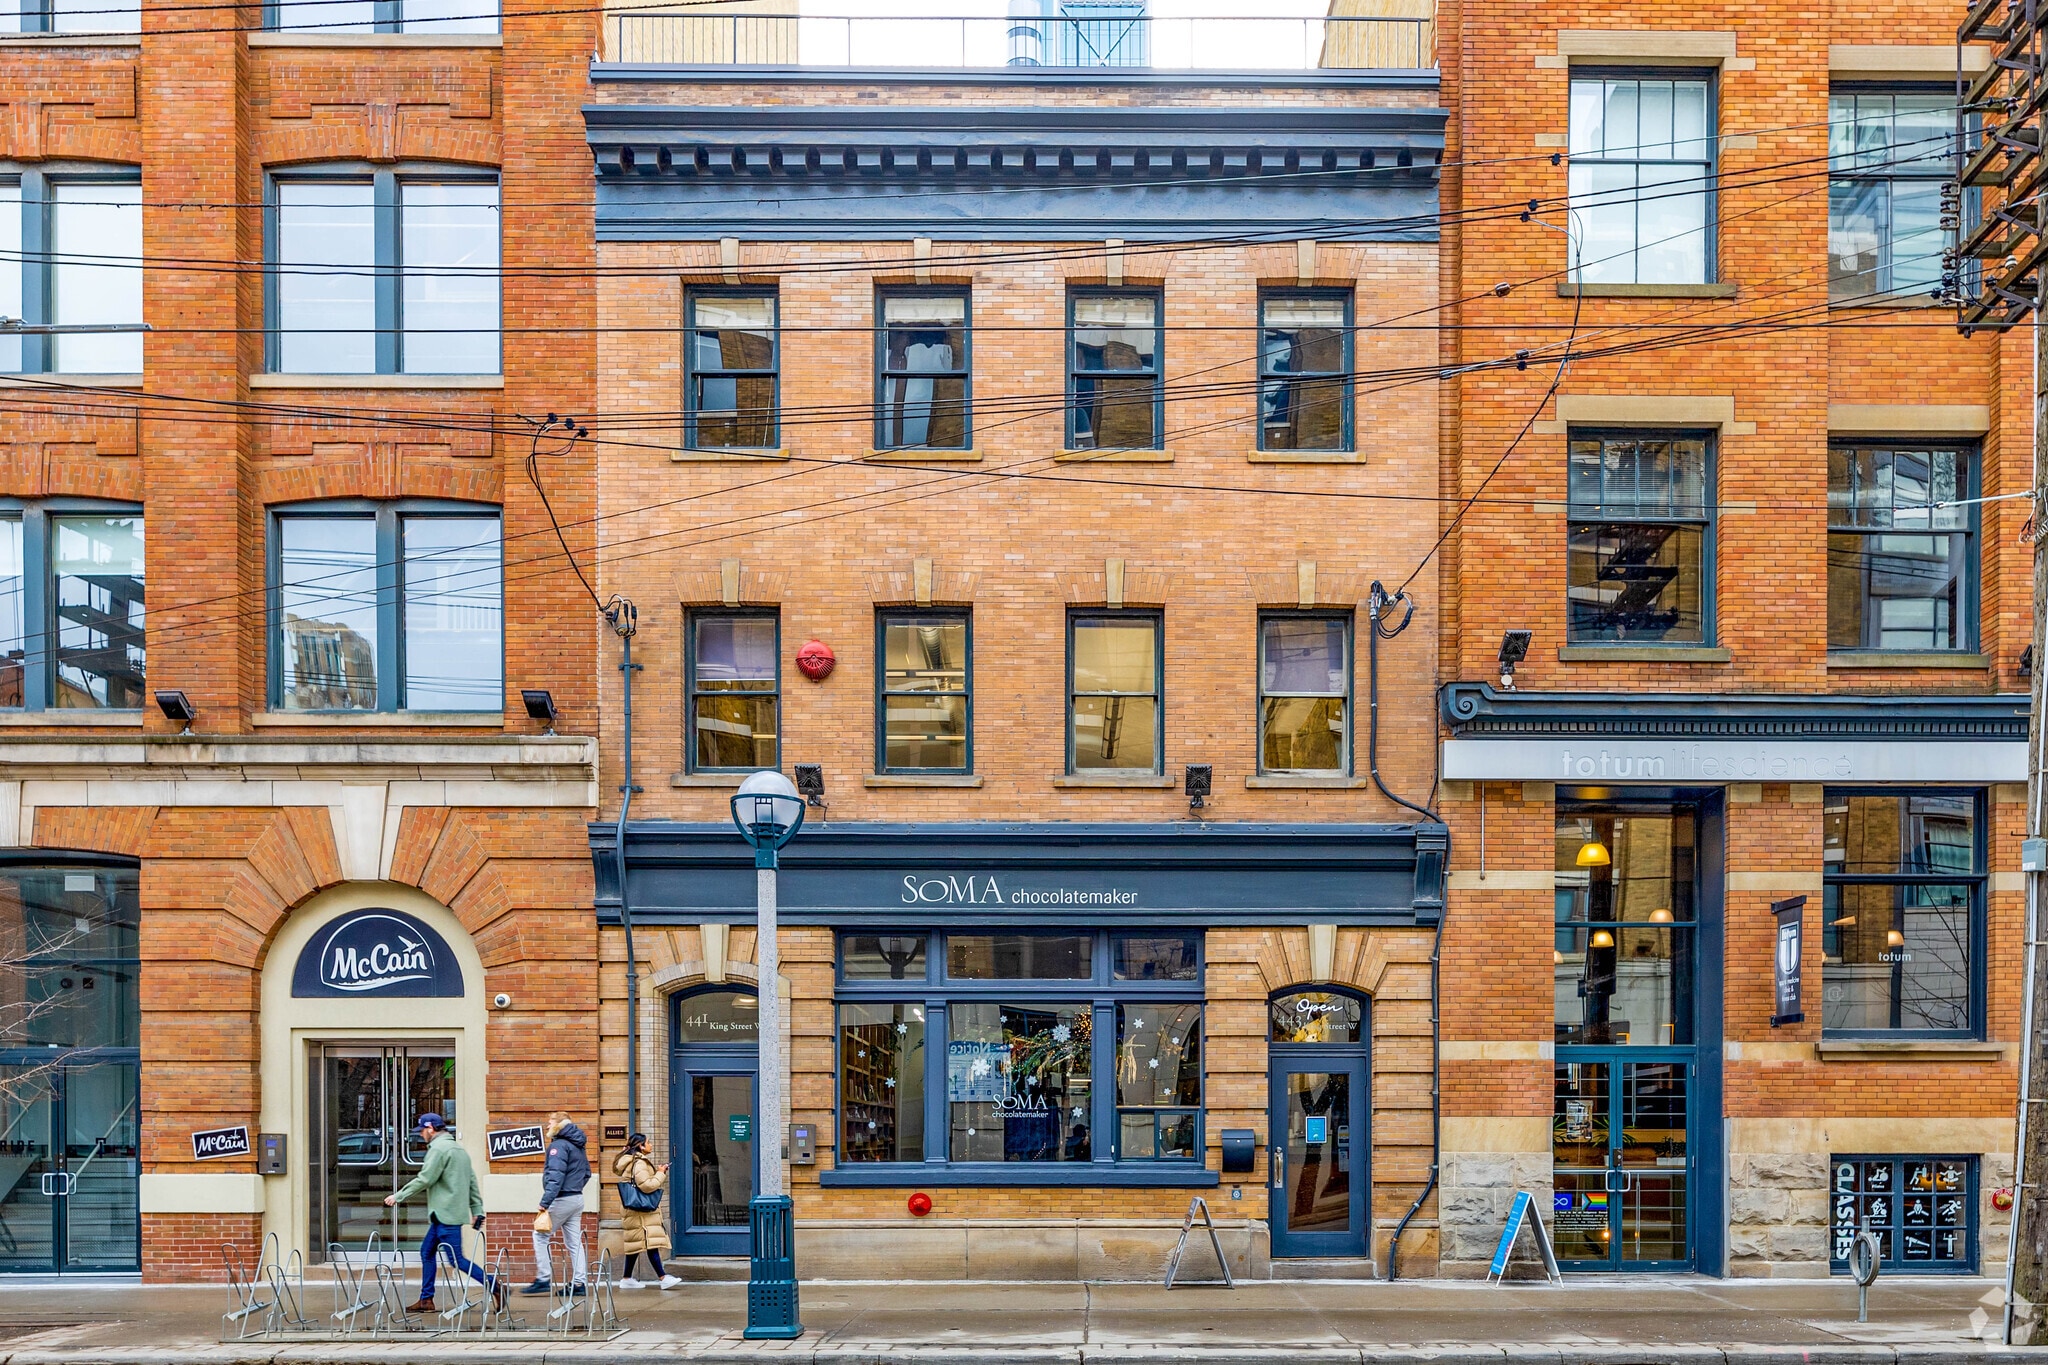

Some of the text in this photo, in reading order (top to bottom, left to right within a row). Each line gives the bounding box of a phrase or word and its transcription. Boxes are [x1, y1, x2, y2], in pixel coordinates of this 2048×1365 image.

[901, 875, 1138, 904] SOMA chocolatemaker
[330, 942, 428, 979] McCain
[1878, 951, 1912, 962] totum
[1296, 998, 1344, 1020] Open
[709, 1022, 729, 1032] King
[730, 1021, 752, 1030] Street
[1278, 1015, 1302, 1030] 443
[1347, 1022, 1358, 1030] W
[991, 1094, 1048, 1110] SOMA
[991, 1110, 1049, 1118] chocolatemaker
[0, 1139, 35, 1152] RIDE
[197, 1134, 248, 1154] McCain
[492, 1134, 543, 1153] McCain
[1837, 1164, 1855, 1260] CLASSES
